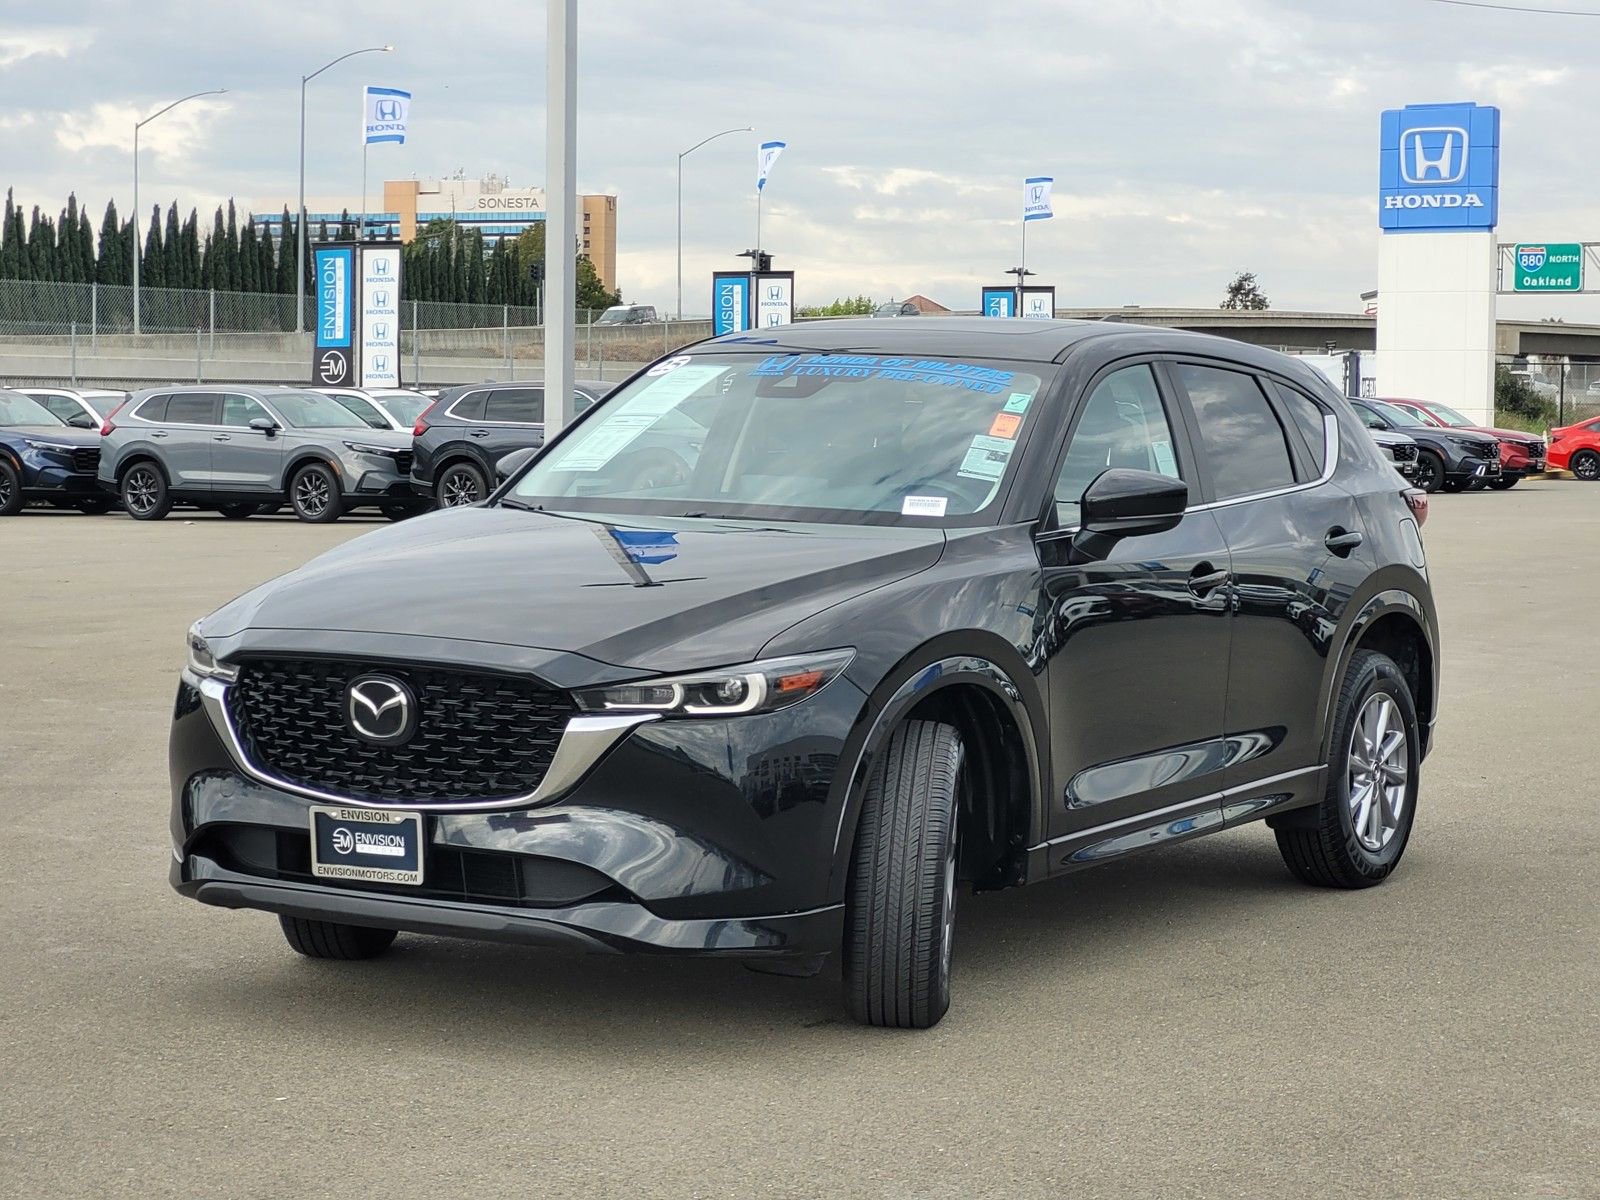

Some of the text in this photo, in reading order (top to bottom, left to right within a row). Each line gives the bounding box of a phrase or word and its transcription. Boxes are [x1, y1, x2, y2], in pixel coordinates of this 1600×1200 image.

[367, 124, 405, 132] HOND
[478, 197, 540, 209] SONESTA
[1384, 193, 1485, 209] HONDA
[1521, 254, 1580, 267] 880 NORTH
[1523, 276, 1572, 286] Oakland
[323, 257, 336, 339] ENVISION
[721, 284, 734, 334] VISION
[803, 355, 1016, 381] HONDA OF MILPITAS
[792, 367, 1005, 394] LUXURY PRE-OWNED
[341, 809, 390, 822] ENVISION
[355, 832, 405, 847] ENVISION
[318, 866, 418, 882] ENVISIONMOTORS.COM
